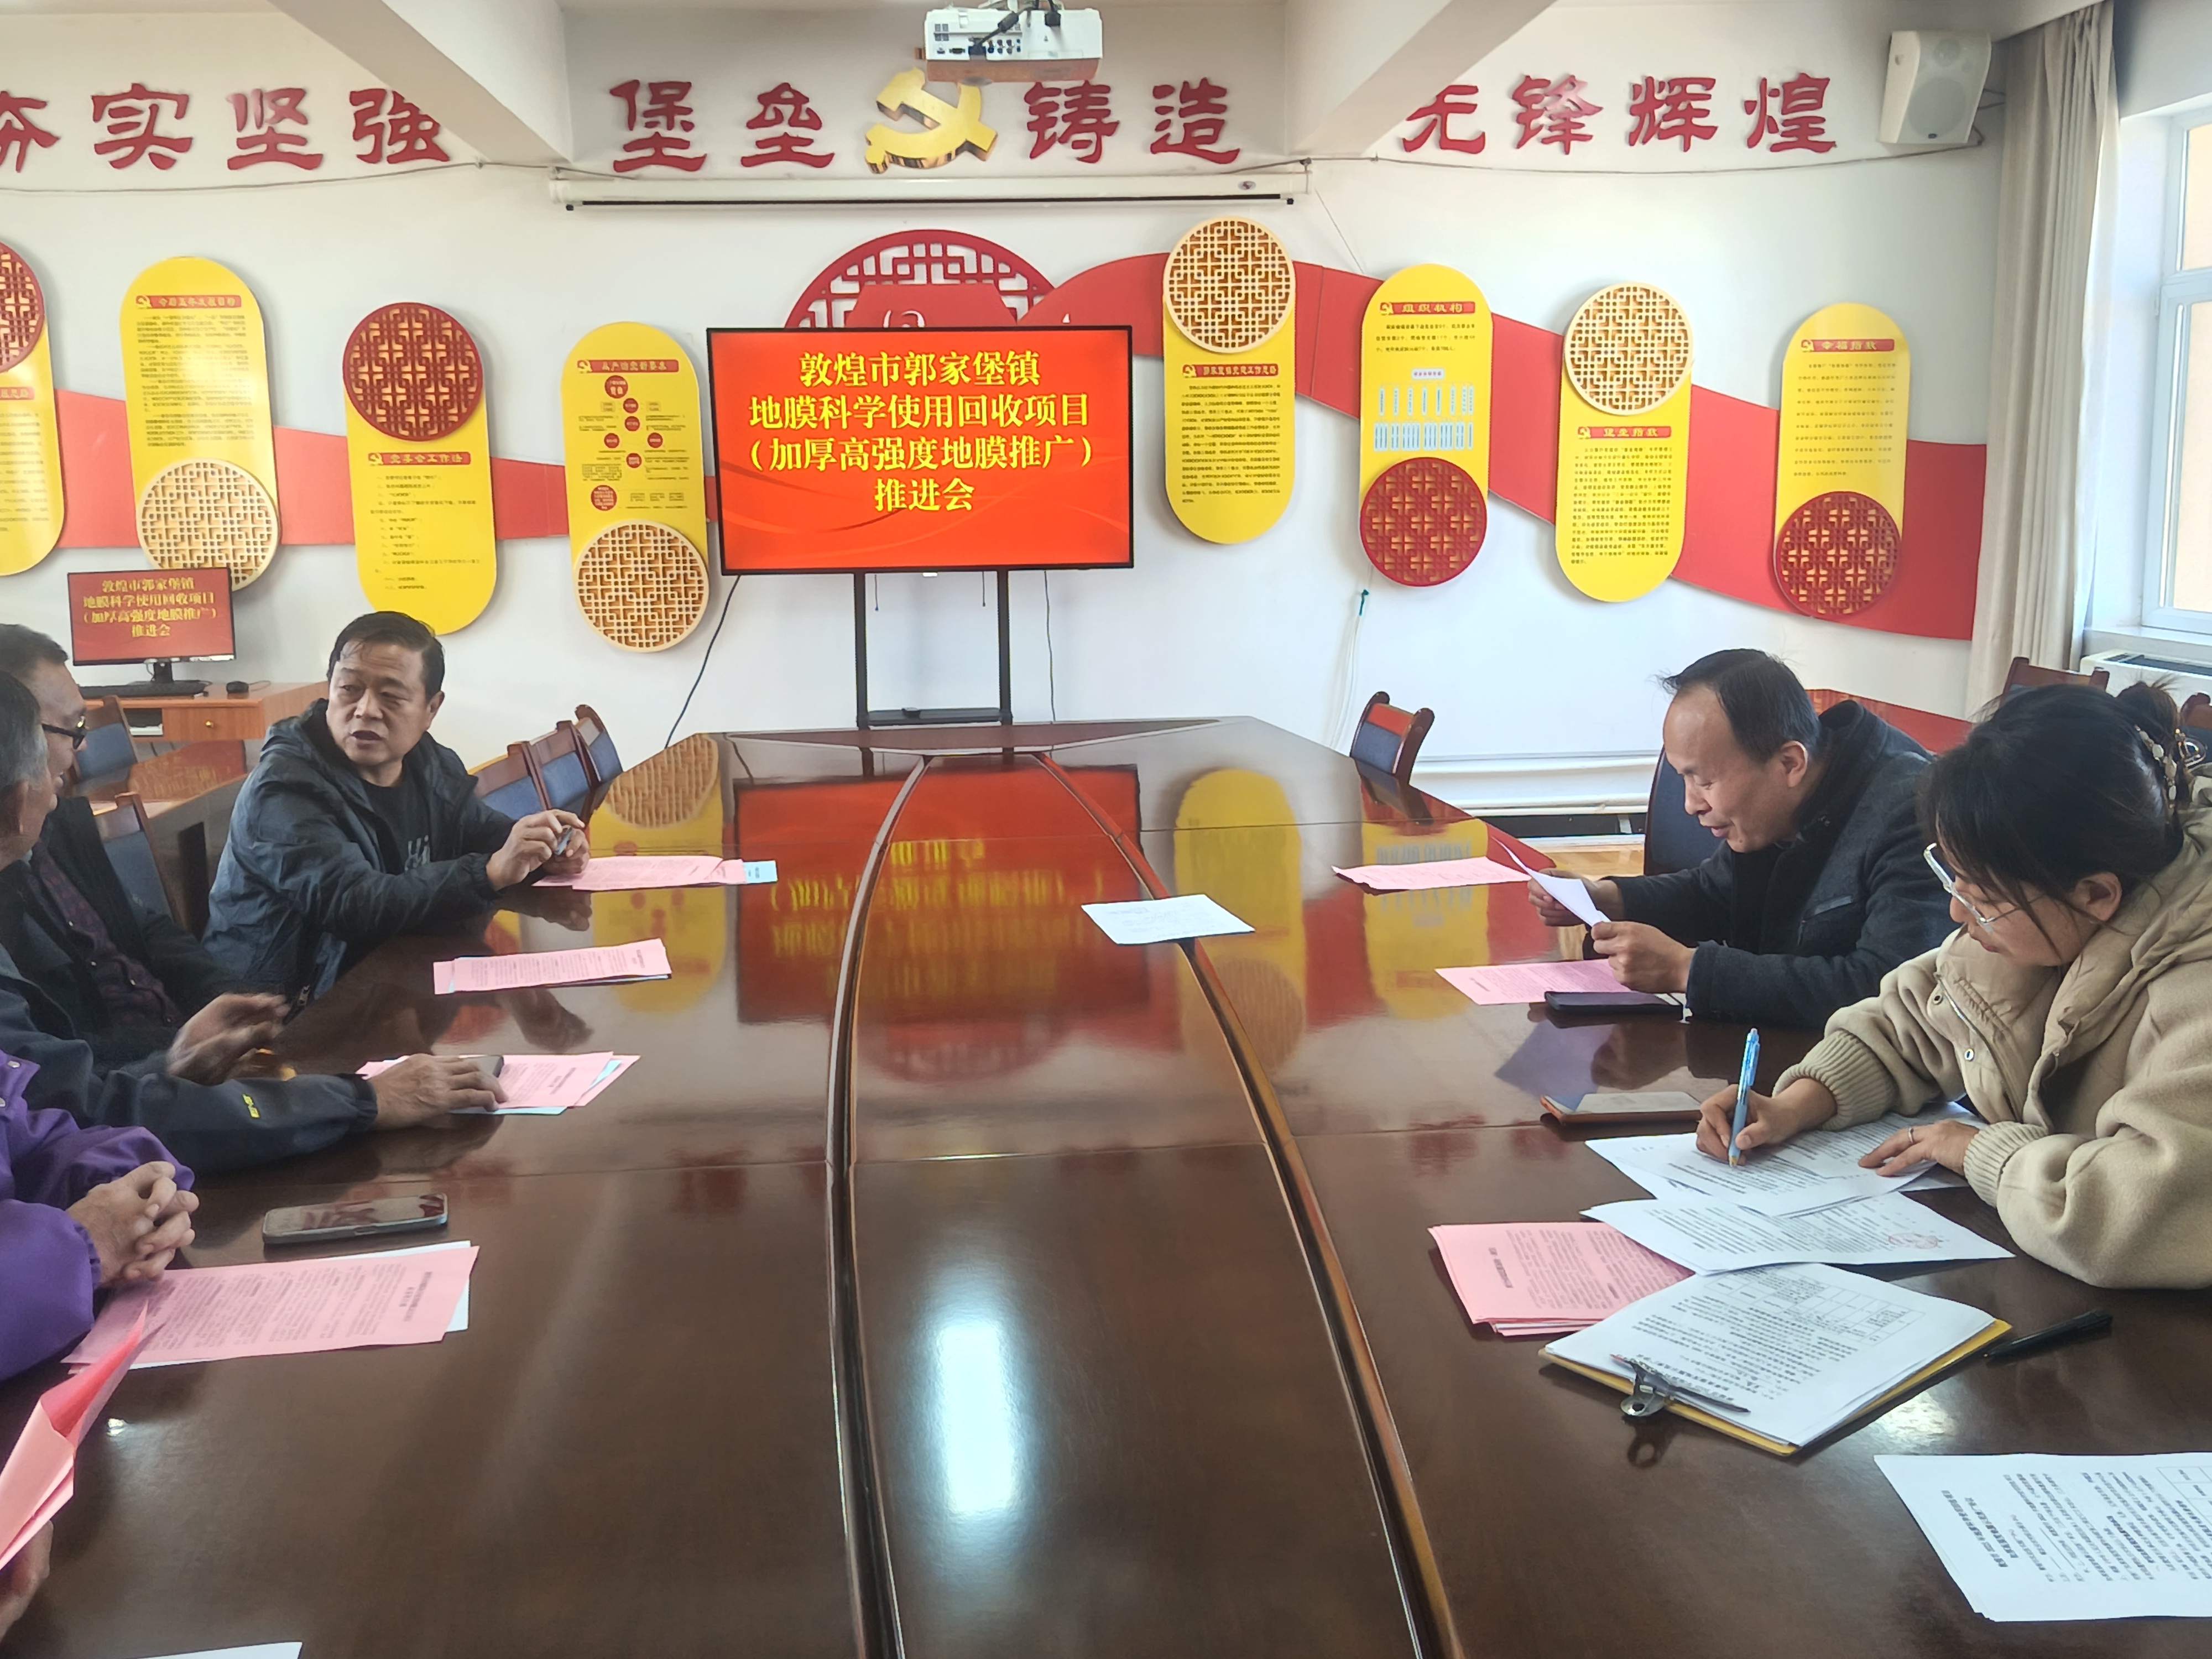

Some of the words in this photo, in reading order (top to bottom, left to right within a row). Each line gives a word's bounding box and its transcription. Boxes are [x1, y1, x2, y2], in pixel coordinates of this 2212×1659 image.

[610, 79, 835, 173] 堡垒
[1023, 77, 1240, 164] 铸造
[800, 351, 1040, 388] 敦煌市郭家堡镇
[749, 393, 1088, 429] 地膜科学使用回收项目
[874, 477, 975, 512] 推进会
[132, 624, 171, 638] 推进会
